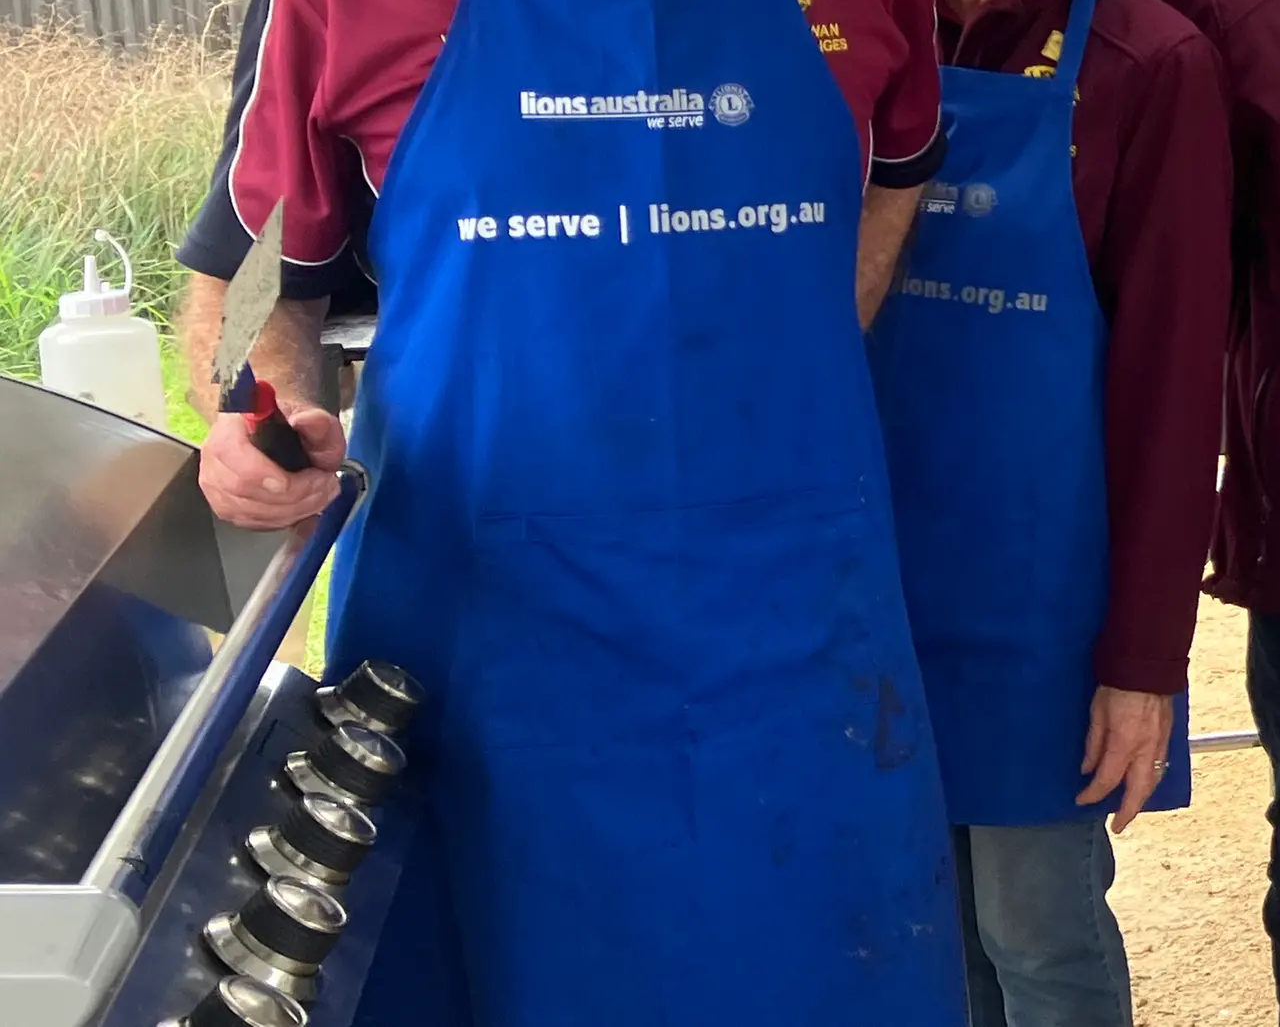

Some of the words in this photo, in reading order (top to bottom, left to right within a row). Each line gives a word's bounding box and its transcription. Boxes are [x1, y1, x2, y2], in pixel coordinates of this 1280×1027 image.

[646, 117, 665, 130] we
[667, 114, 704, 129] serve
[457, 214, 498, 241] we
[507, 212, 601, 239] serve
[649, 202, 825, 235] lions.org.au
